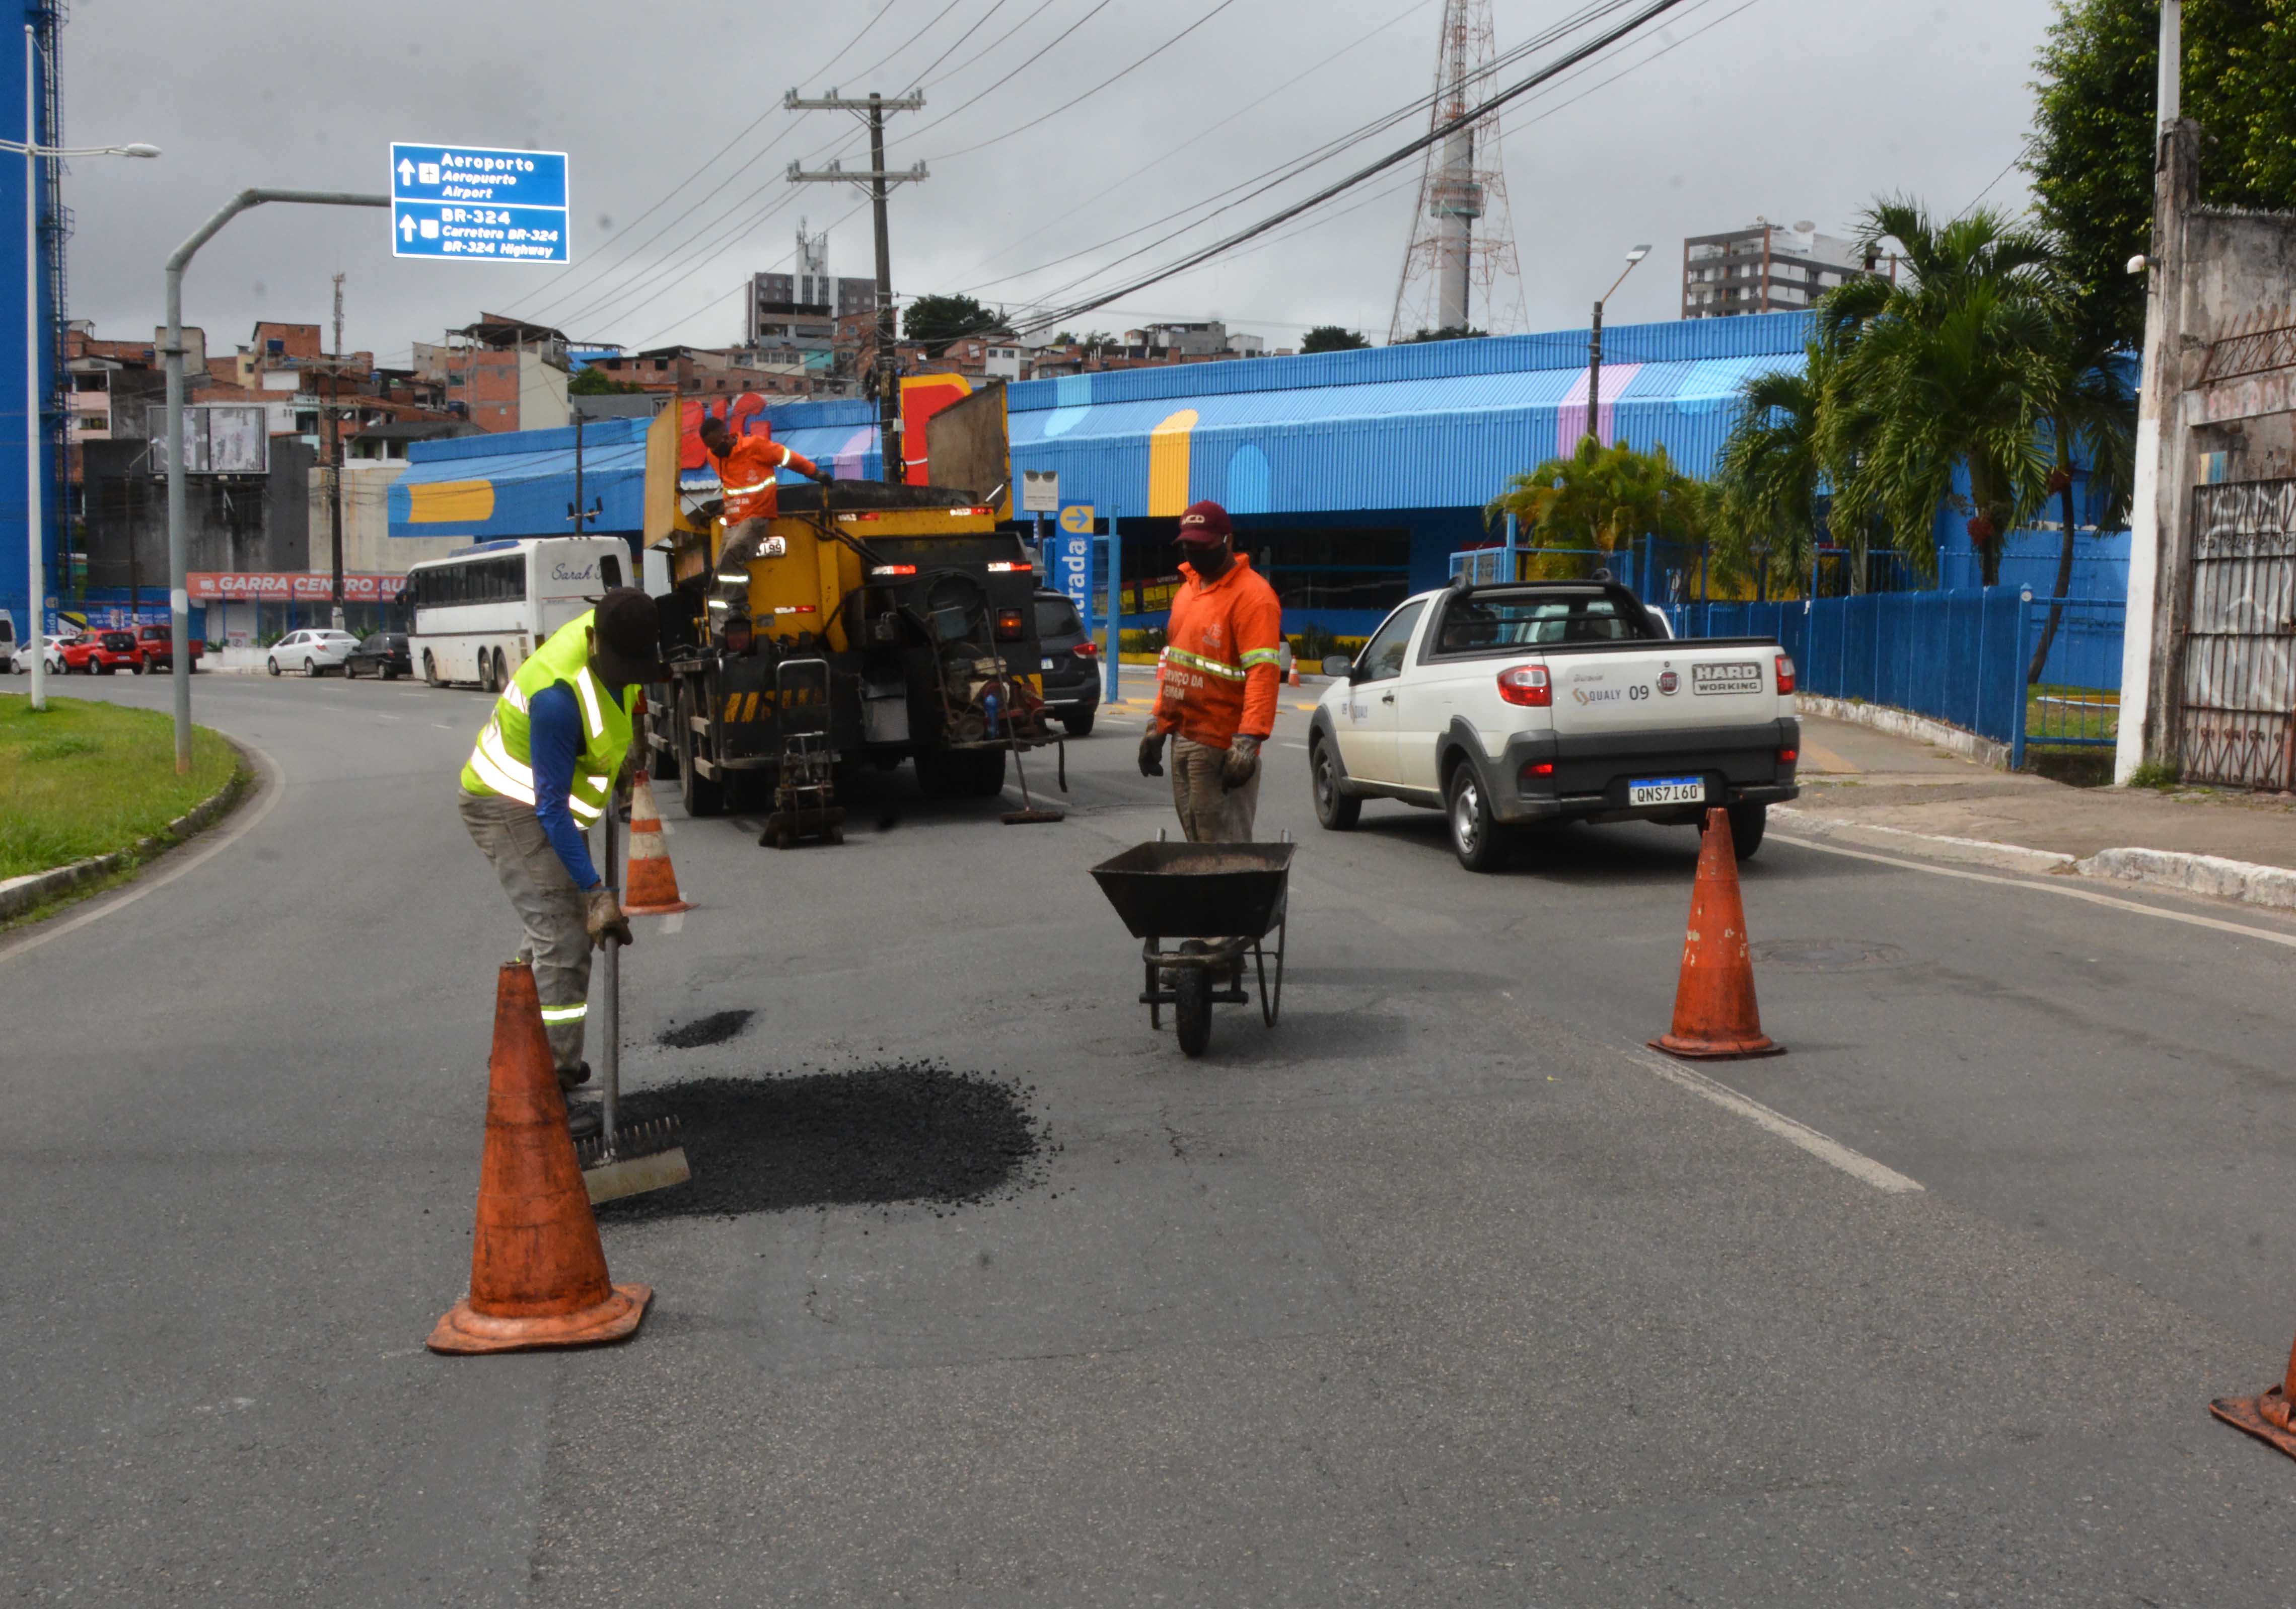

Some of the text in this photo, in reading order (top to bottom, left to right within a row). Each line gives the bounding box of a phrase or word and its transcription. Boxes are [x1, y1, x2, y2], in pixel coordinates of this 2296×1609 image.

[441, 153, 534, 171] Aeroporto
[442, 171, 517, 185] Aeropuerto
[442, 185, 493, 199] Airport
[442, 208, 511, 225] BR-324
[442, 225, 558, 242] Carretera BR-324
[443, 241, 553, 258] BR-324 Highway
[552, 563, 593, 580] Sarah
[219, 576, 289, 591] GARRA
[295, 578, 373, 592] CENRO
[1191, 675, 1203, 688] DA
[1696, 666, 1757, 681] HARD
[1589, 685, 1649, 701] QUALY 09
[1698, 682, 1758, 692] WORKING
[1637, 785, 1697, 802] QNS7I60
